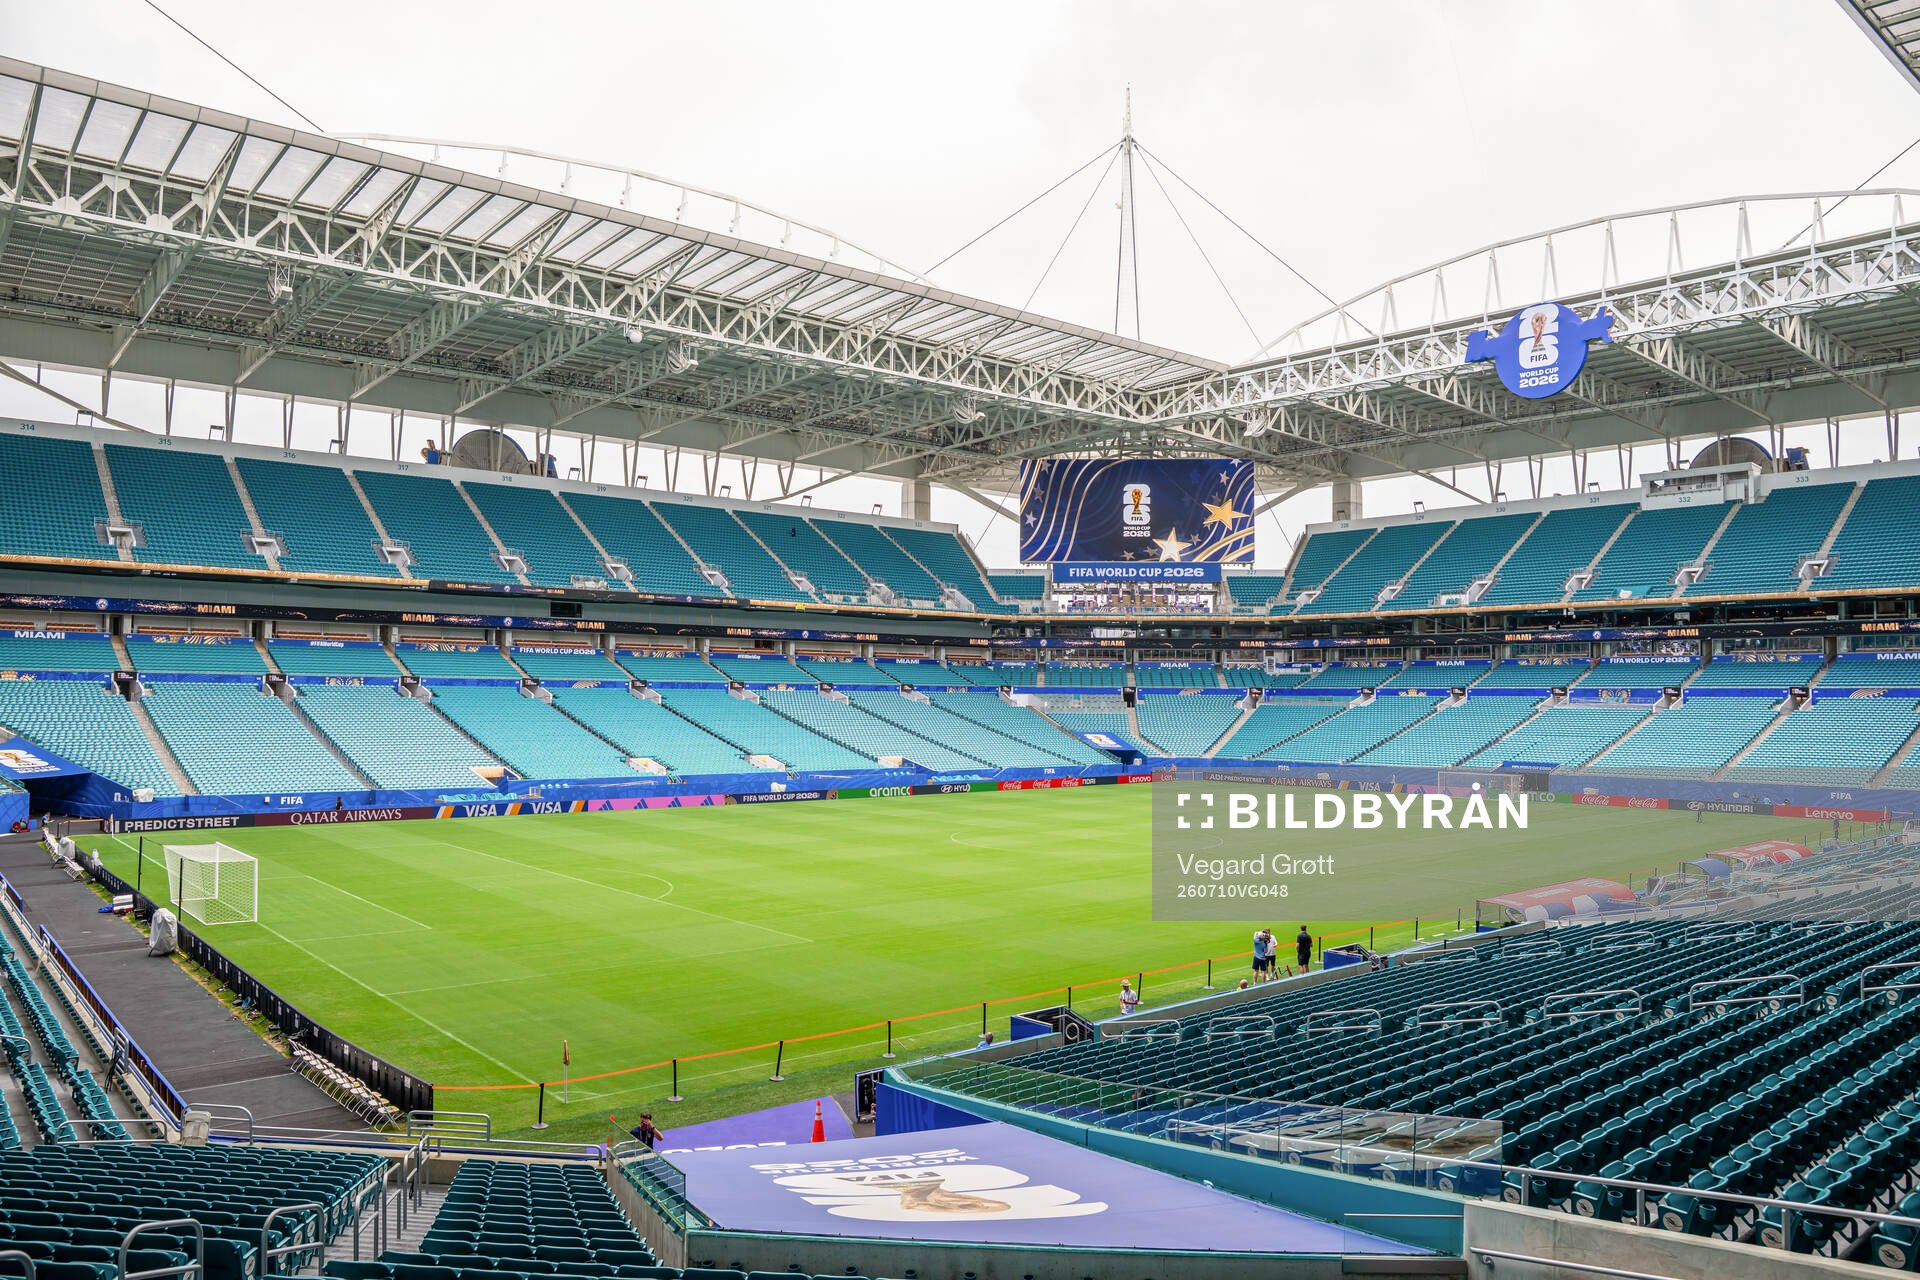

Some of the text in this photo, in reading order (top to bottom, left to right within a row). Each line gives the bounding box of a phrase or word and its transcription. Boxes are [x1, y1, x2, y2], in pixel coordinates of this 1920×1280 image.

[1530, 354, 1548, 362] FIFA
[1520, 367, 1560, 378] WORLD CUP
[1520, 374, 1560, 388] 2026
[158, 438, 172, 446] 315
[1069, 568, 1204, 577] FIFA WORLD CUP 2026
[198, 604, 236, 614] MIAMI
[402, 614, 435, 622] MIAMI
[577, 621, 605, 629] MIAMI
[1862, 623, 1899, 631] MIAMI
[14, 630, 65, 639] MIAMI
[1270, 777, 1332, 787] QATAR AIRWAYS
[1358, 781, 1380, 791] VISA
[280, 796, 303, 805] FIFA
[464, 804, 497, 817] VISA
[530, 802, 562, 814] VISA
[1707, 803, 1753, 813] HYUNDAI
[290, 809, 402, 825] QATAR AIRWAYS
[1805, 808, 1854, 820] Lenovo
[125, 817, 239, 832] PREDICTSTREET
[749, 1148, 967, 1170] 2026
[760, 1156, 980, 1175] WORLD CUP
[834, 1171, 942, 1182] FIFA
